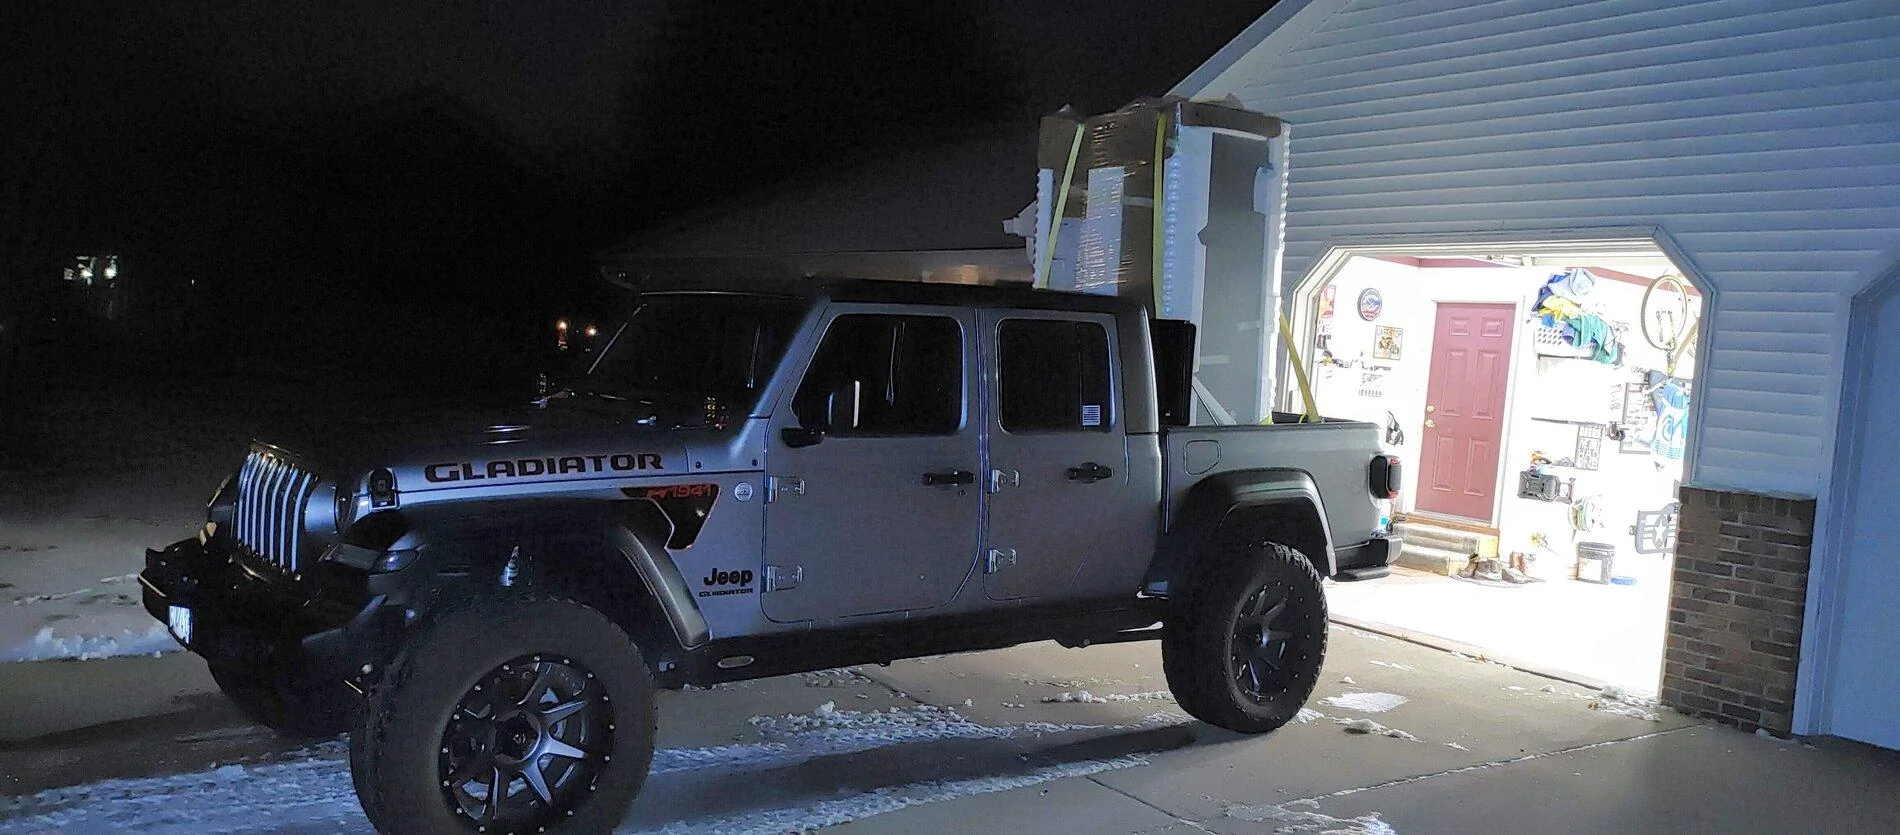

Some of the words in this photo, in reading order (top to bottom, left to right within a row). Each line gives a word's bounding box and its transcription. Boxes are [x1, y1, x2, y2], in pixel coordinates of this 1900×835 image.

[424, 453, 664, 483] GLADIATOR
[703, 567, 753, 587] Jeep
[699, 588, 753, 598] GLADIATOR
